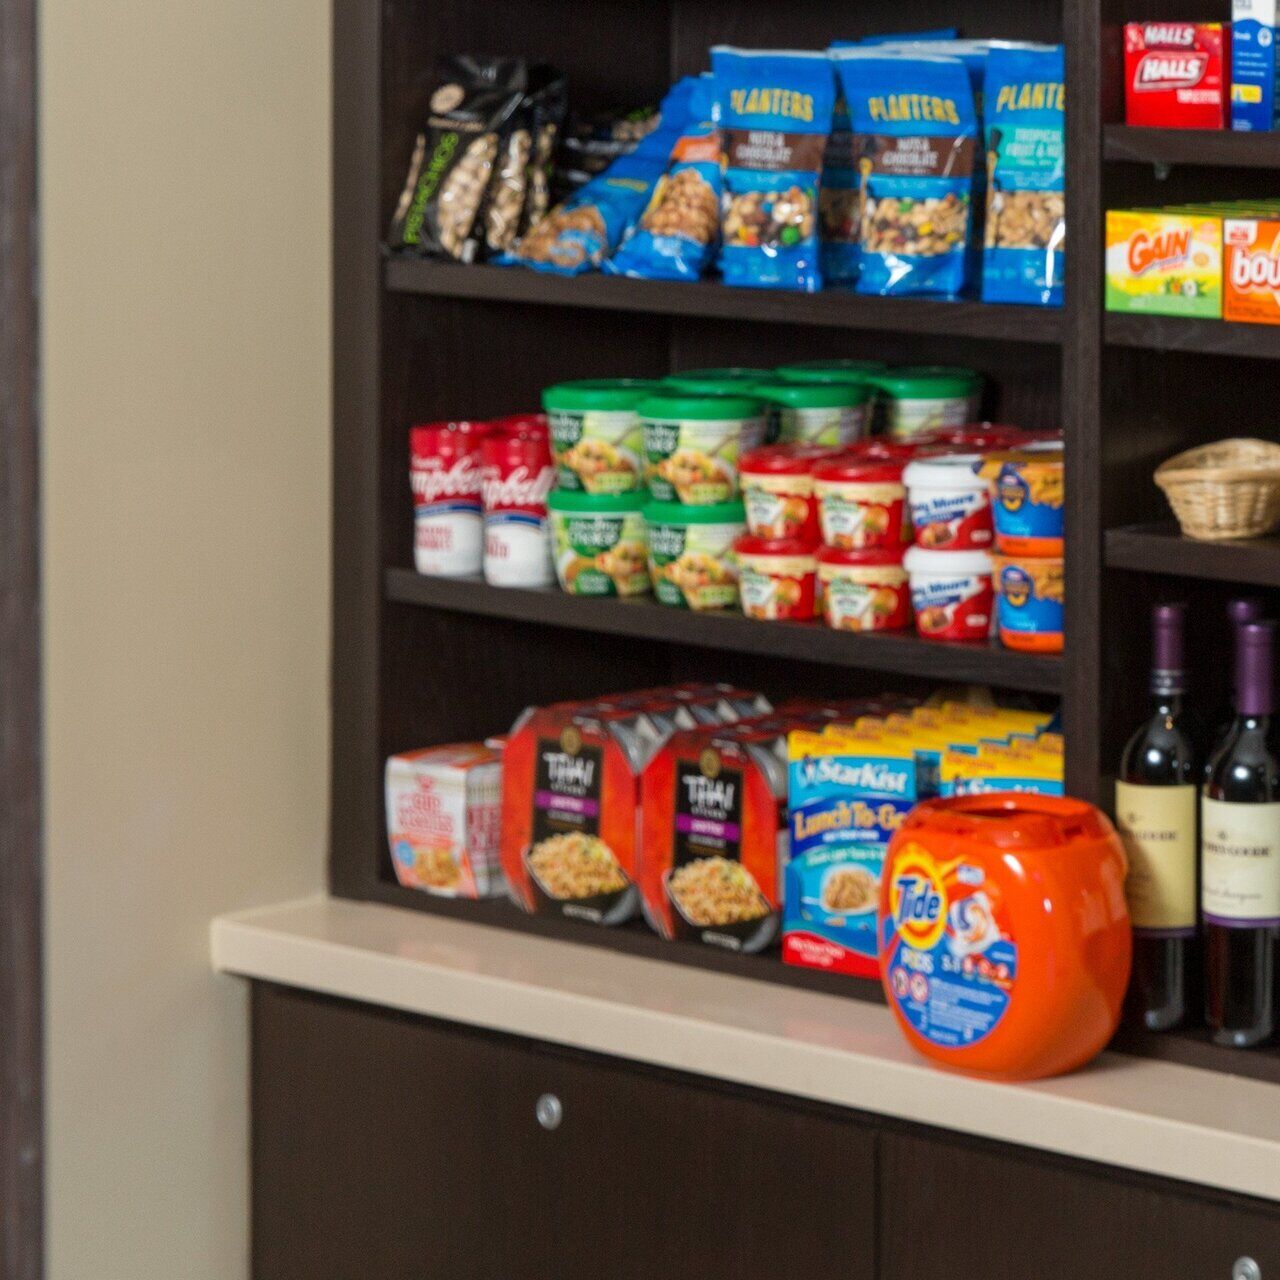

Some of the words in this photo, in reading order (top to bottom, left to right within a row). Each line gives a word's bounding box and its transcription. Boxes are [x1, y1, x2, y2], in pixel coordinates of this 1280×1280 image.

[1143, 25, 1195, 45] HALLS
[1143, 58, 1201, 81] HALLS
[730, 88, 814, 122] PLANTERS
[868, 94, 961, 126] PLANTERS
[997, 82, 1065, 113] PLANTE
[1128, 229, 1193, 275] GAIN
[818, 756, 908, 793] StarKist
[794, 800, 851, 841] Lunch
[897, 879, 941, 926] Tide
